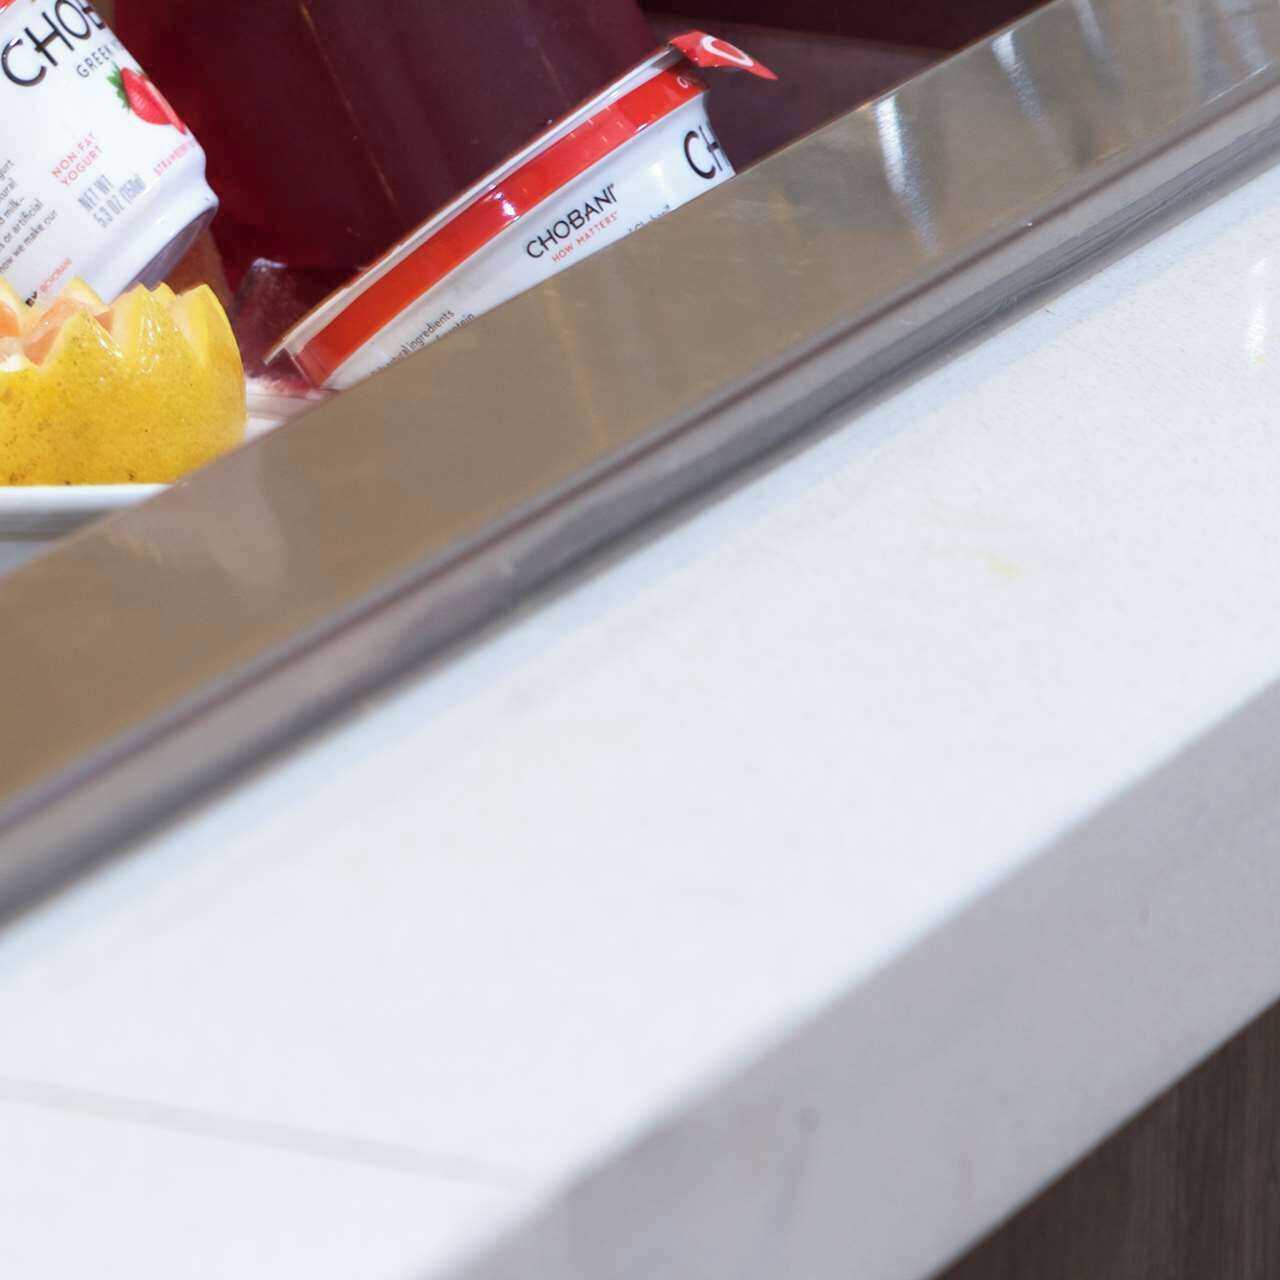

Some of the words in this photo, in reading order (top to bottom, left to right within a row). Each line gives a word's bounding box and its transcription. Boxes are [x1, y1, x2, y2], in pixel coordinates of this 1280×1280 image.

[76, 44, 114, 79] GREEK
[51, 130, 97, 178] NON-FAT
[60, 145, 103, 187] YOGURT
[12, 198, 45, 235] artificial
[12, 242, 26, 258] we
[22, 223, 47, 247] make
[42, 208, 59, 226] our
[526, 184, 618, 259] CHOBANI
[551, 244, 576, 264] HOW
[575, 213, 618, 246] MATTERS
